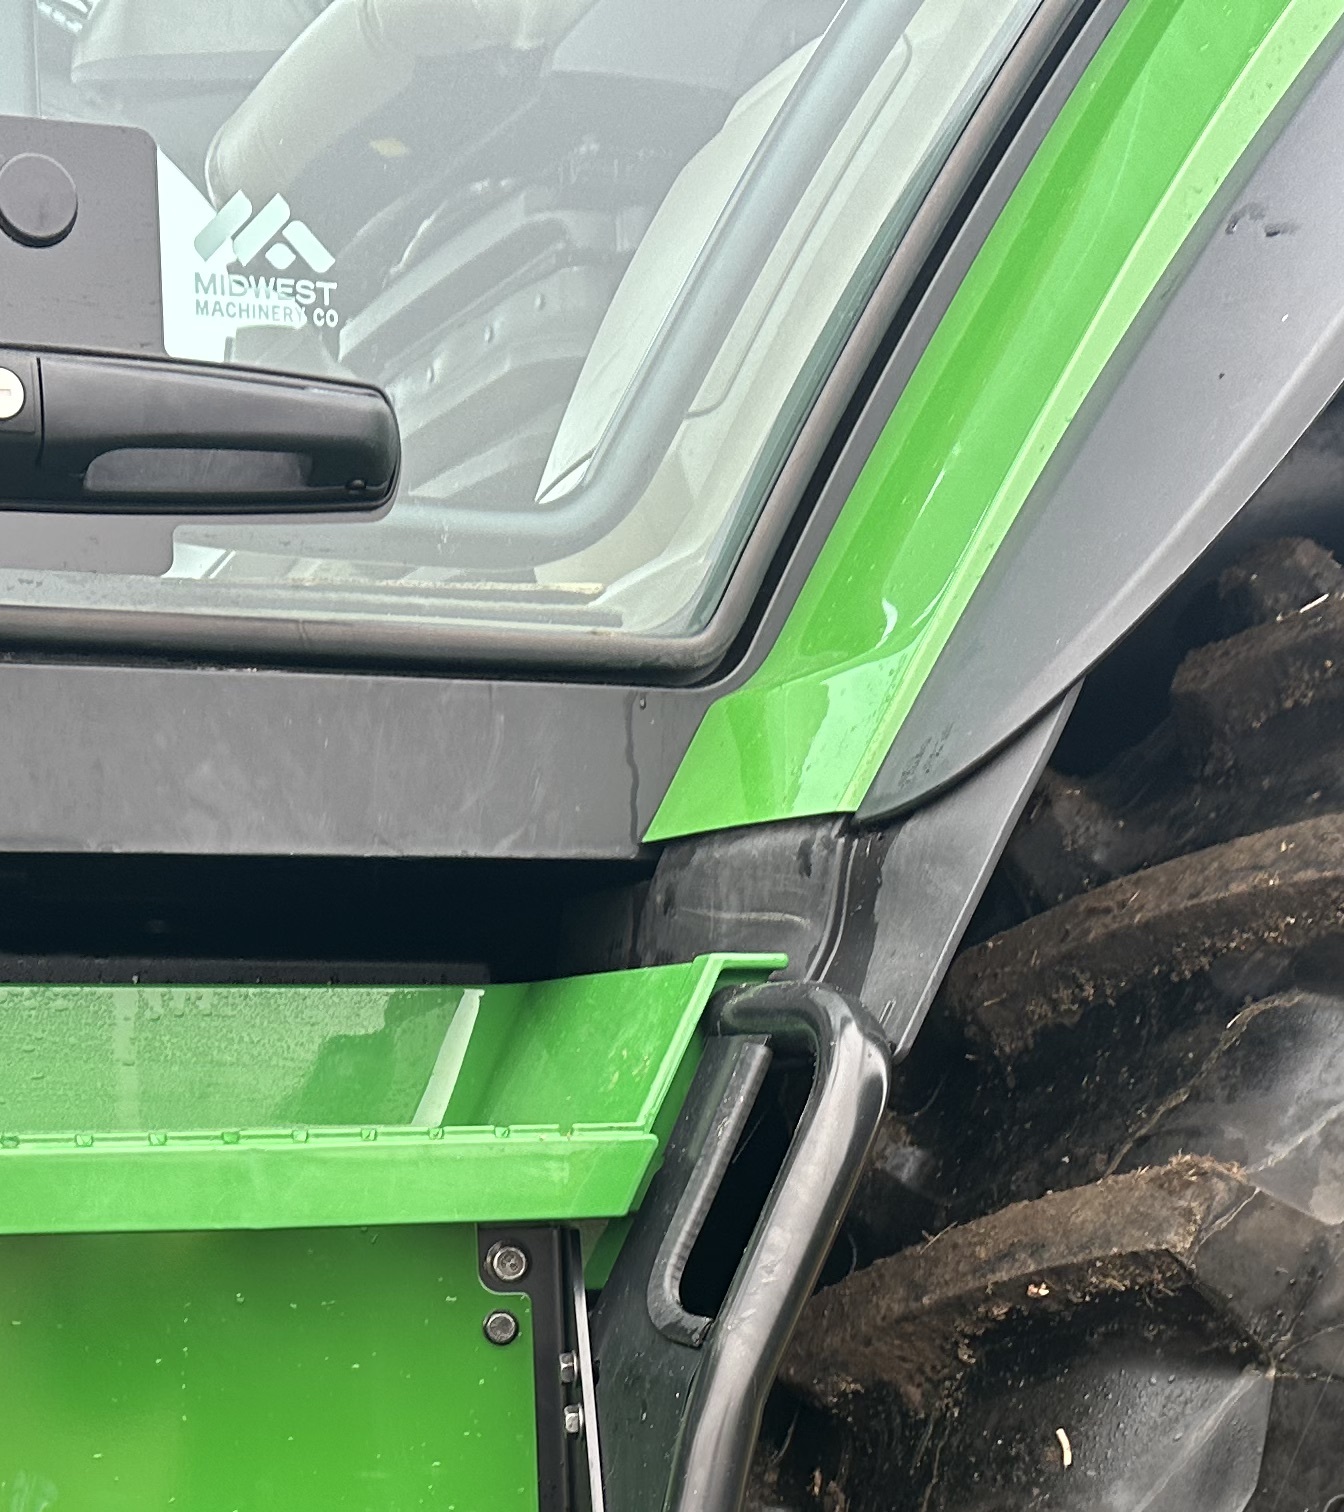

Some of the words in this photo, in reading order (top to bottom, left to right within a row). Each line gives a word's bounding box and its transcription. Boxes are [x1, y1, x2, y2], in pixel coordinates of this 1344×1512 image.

[194, 272, 338, 306] MIDWEST
[195, 299, 306, 323] MACHINERY
[312, 307, 339, 328] CO
